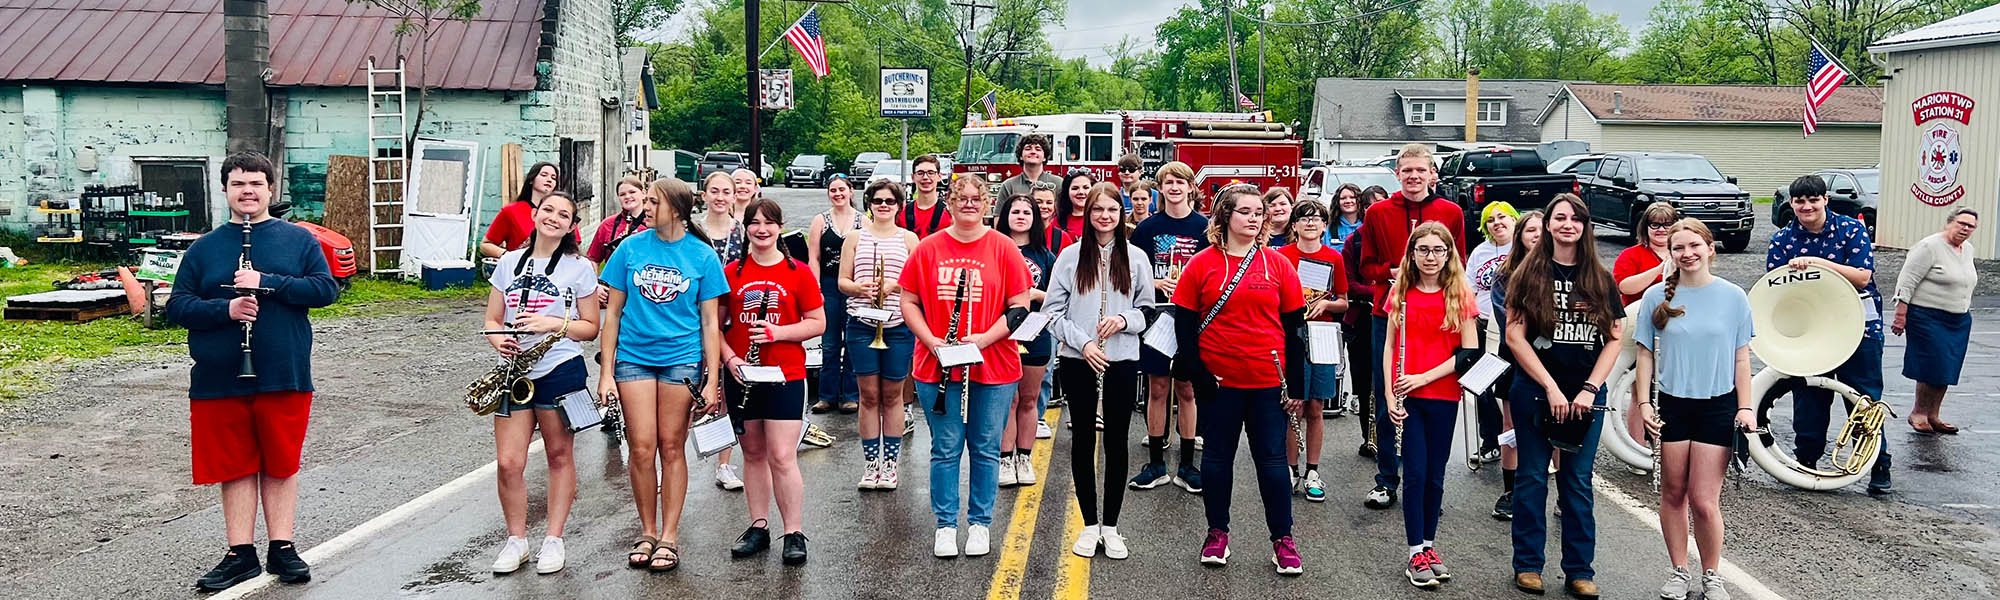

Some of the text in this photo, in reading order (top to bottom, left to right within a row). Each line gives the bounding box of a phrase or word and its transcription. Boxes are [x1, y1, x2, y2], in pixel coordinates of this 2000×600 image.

[884, 72, 924, 86] BUTCHERINE'S
[1913, 94, 1973, 112] MARION TWP
[1920, 106, 1964, 121] STATION 31
[1932, 129, 1948, 139] FIRE
[1268, 165, 1296, 178] E-31
[1928, 175, 1947, 184] RESCUE
[1911, 184, 1963, 205] BUTLER COUNTY
[938, 266, 984, 287] USA
[1767, 271, 1821, 288] KING
[739, 312, 782, 325] OLD AVY
[1553, 322, 1598, 342] BRAVE
